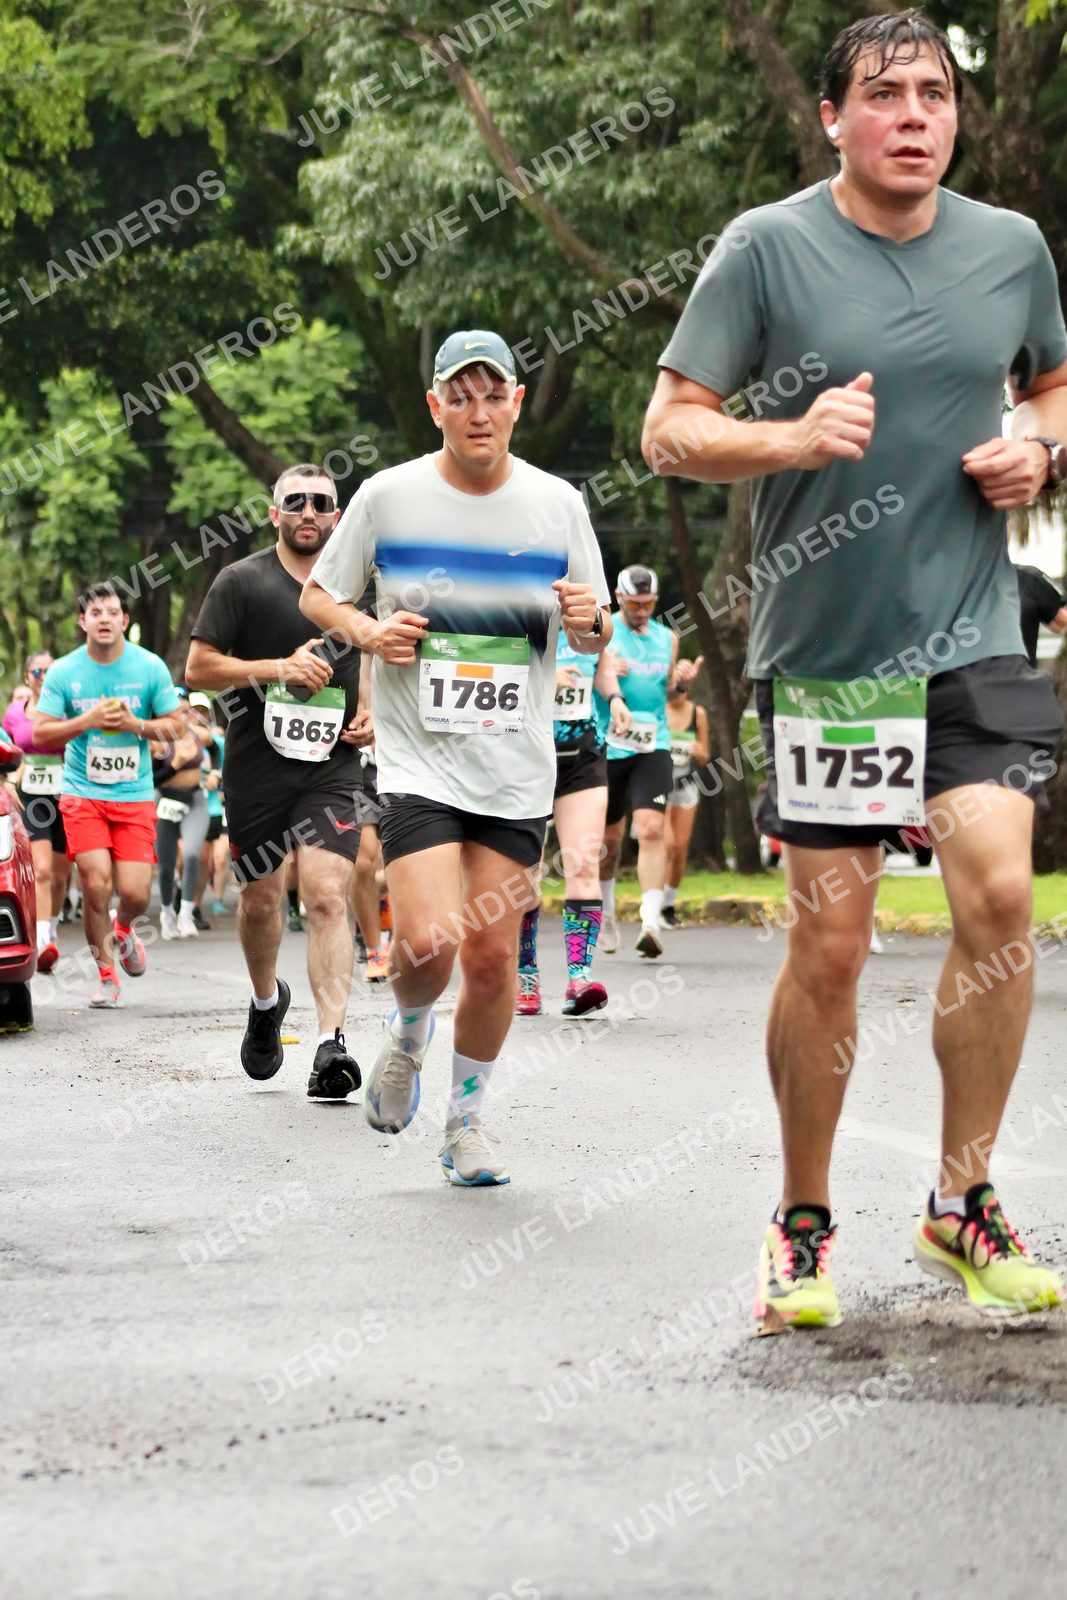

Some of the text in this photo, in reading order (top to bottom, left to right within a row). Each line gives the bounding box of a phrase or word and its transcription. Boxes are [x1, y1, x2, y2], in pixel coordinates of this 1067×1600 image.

[429, 678, 520, 711] 1786
[272, 716, 337, 744] 1863
[612, 730, 652, 743] 745
[91, 757, 136, 771] 4304
[789, 744, 914, 789] 1752
[29, 774, 53, 784] 971
